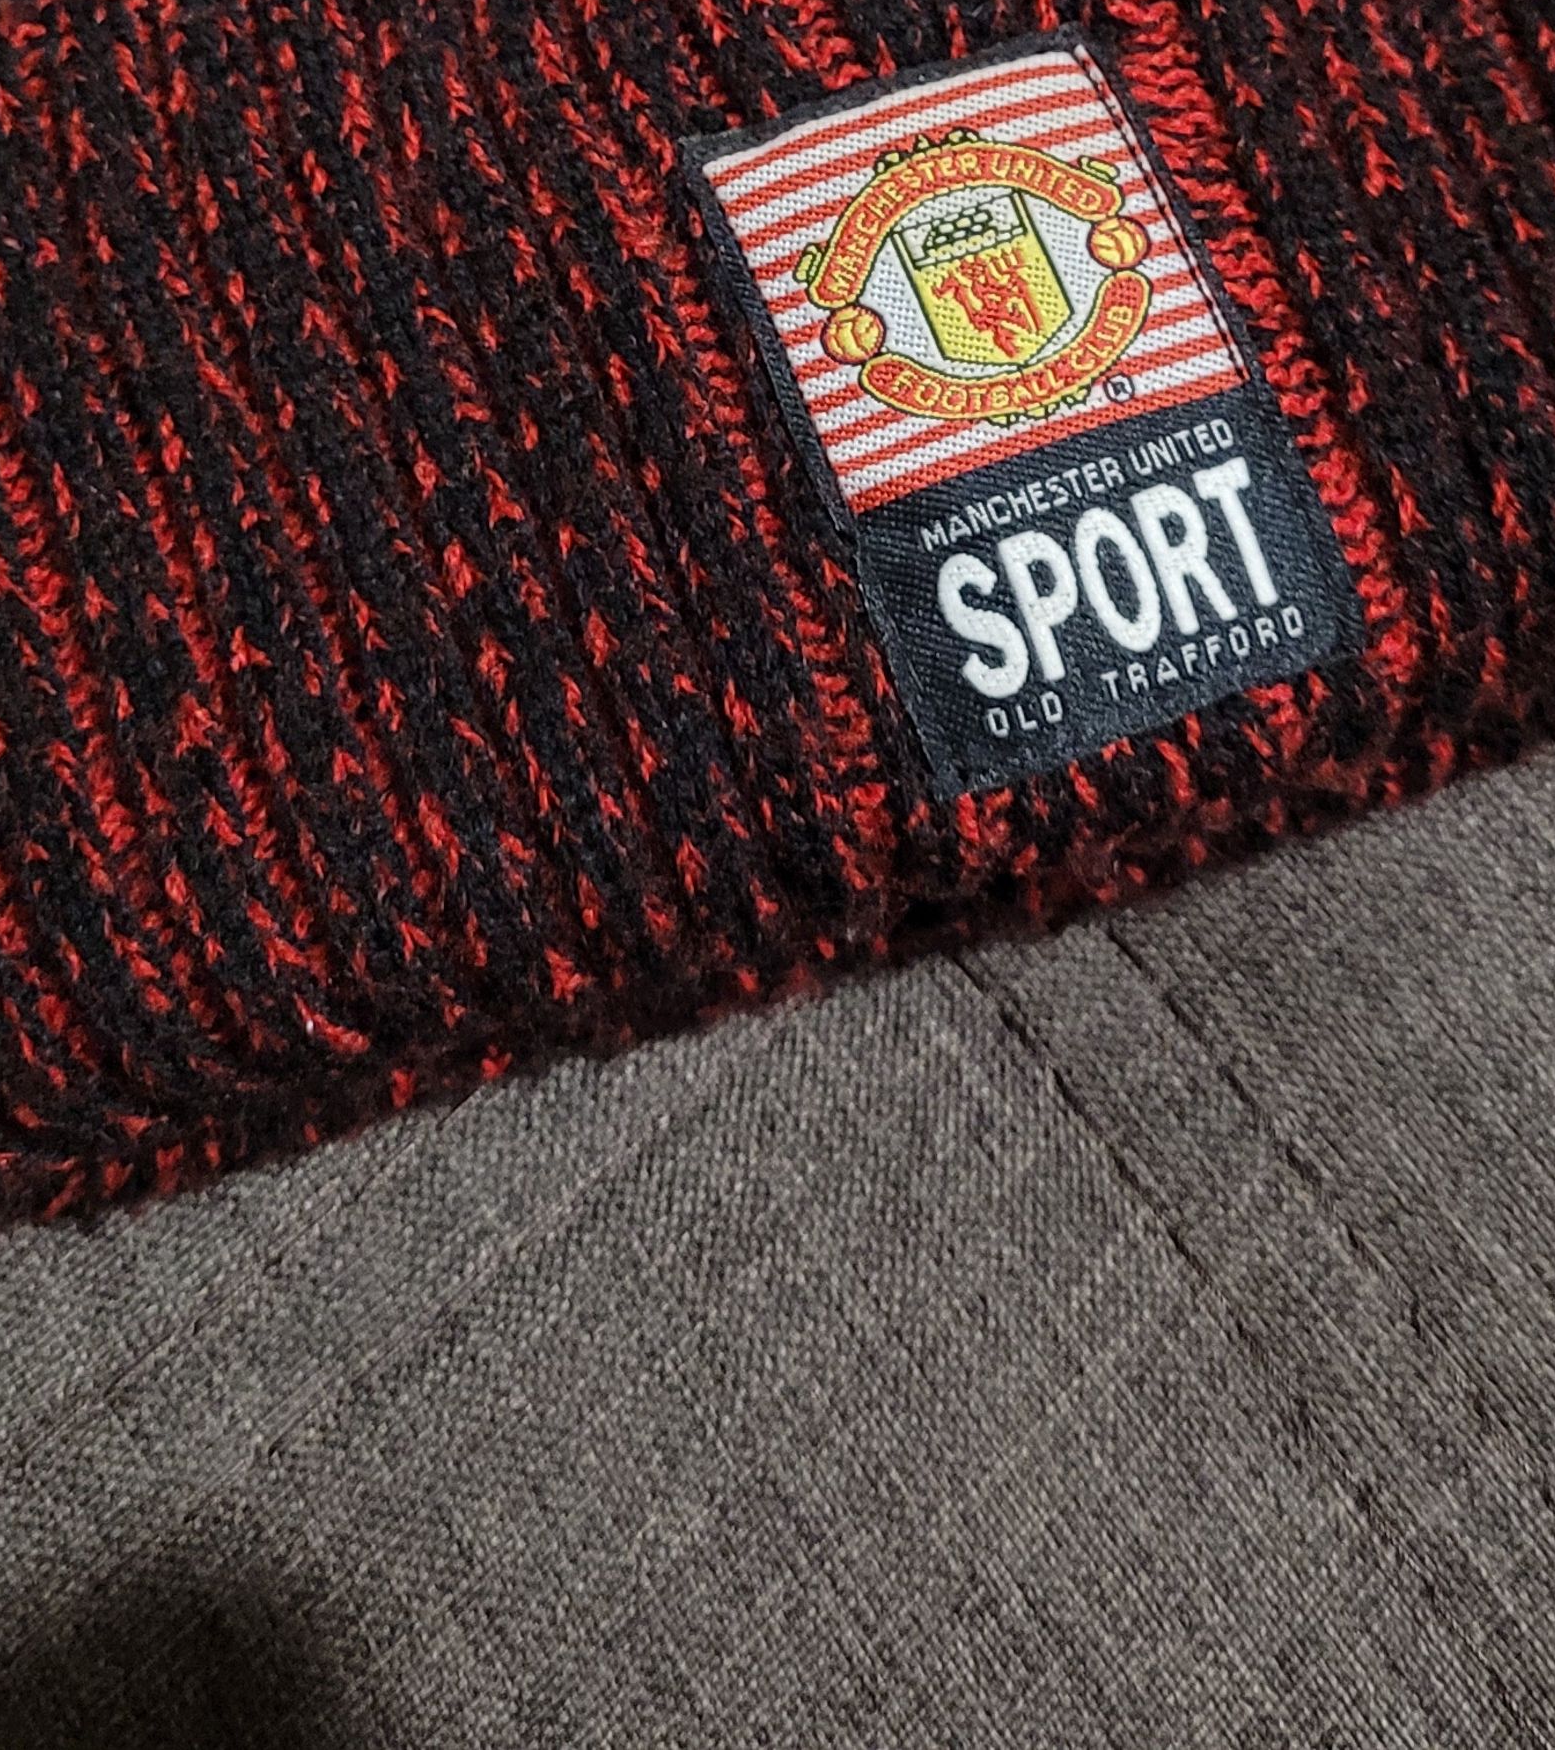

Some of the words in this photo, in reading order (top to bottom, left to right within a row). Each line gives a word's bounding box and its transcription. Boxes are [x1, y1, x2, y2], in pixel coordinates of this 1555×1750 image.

[828, 150, 981, 299] MANCHESTER
[990, 154, 1103, 215] UNITED
[892, 361, 1068, 413] FOOTBALL
[1067, 306, 1132, 372] CLUB
[920, 460, 1126, 552] MANCHESTER
[1127, 417, 1235, 477] UNITED
[936, 455, 1279, 700] SPORT
[986, 691, 1065, 739] OLD
[1099, 606, 1306, 703] TRAFFORD
